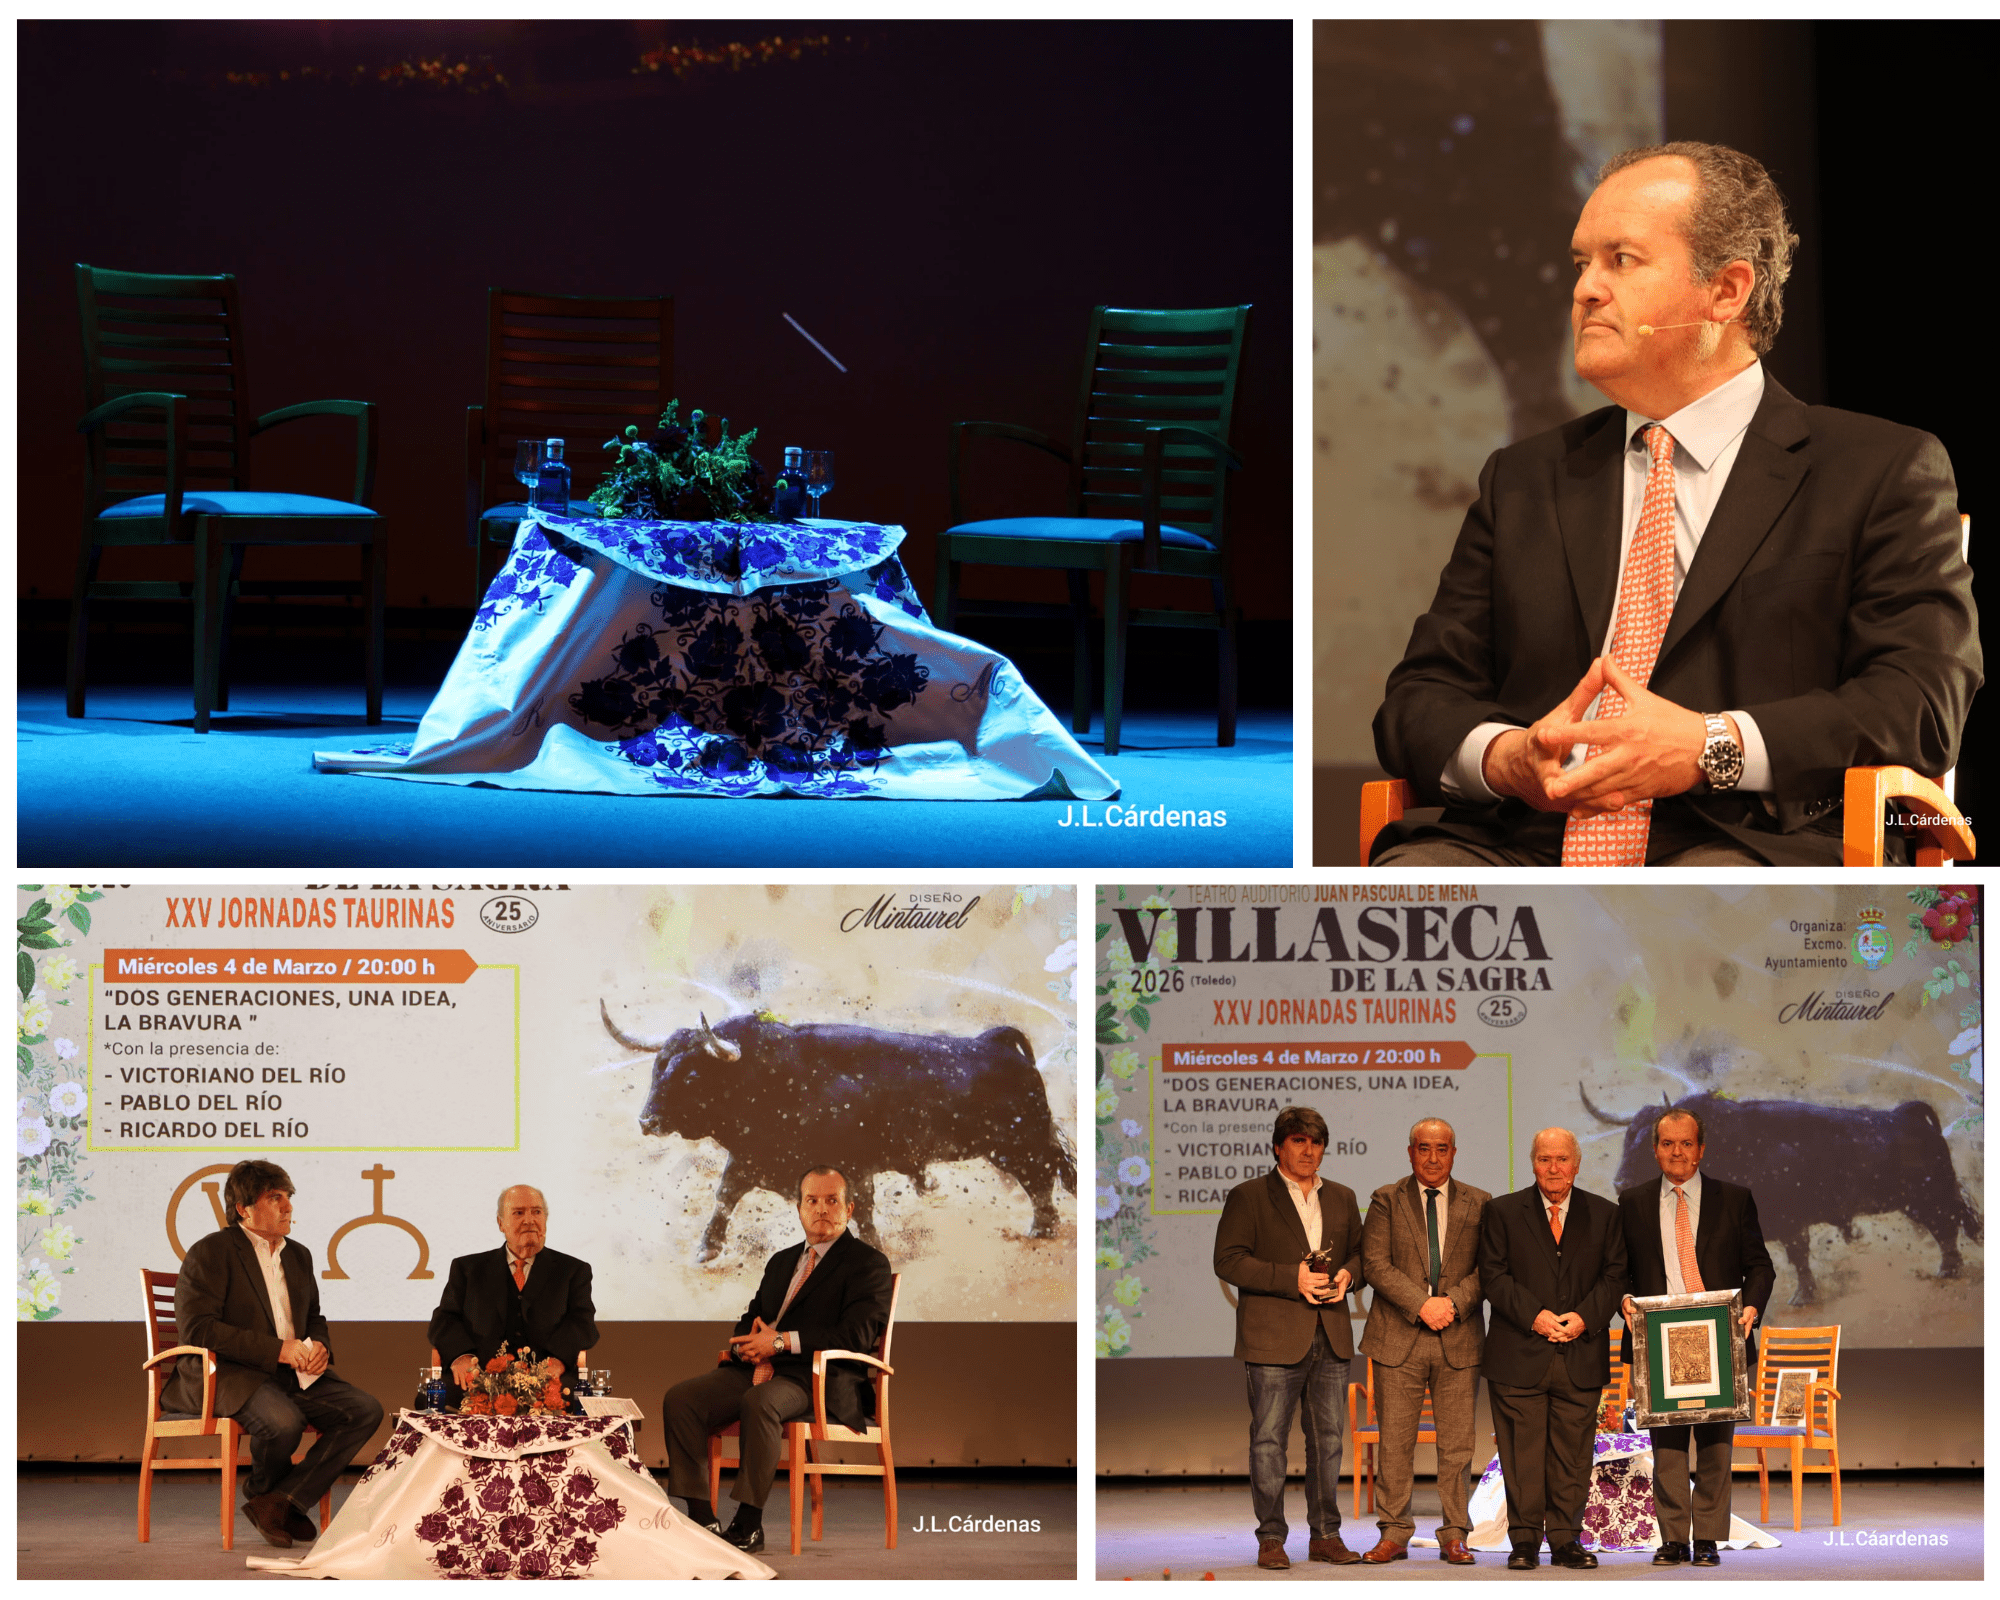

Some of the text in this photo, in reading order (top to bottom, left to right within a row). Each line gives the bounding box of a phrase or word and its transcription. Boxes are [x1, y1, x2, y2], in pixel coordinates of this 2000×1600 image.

[909, 892, 963, 903] DISEÑO
[1187, 884, 1479, 902] TEATRO AUDITORIO JUAN PASCUAL DE MENA
[165, 896, 455, 928] XXV JORNADAS TAURINAS
[495, 901, 521, 921] 25
[840, 893, 981, 933] Mintaurel
[483, 915, 536, 931] ANIVERSARIO
[1790, 919, 1846, 935] Organiza:
[1112, 904, 1554, 963] VILLASECA
[1804, 937, 1847, 950] Excmo.
[118, 957, 218, 975] Miércoles
[223, 959, 236, 975] 4
[242, 957, 267, 975] de
[273, 959, 337, 975] Marzo
[357, 958, 416, 975] 20:00
[422, 957, 435, 975] h
[1765, 955, 1847, 971] Ayuntamiento
[1131, 969, 1236, 993] 2026 (Toledo)
[1330, 966, 1554, 992] DE LA SAGRA
[167, 990, 341, 1009] GENERACIONES,
[349, 990, 395, 1006] UNA
[402, 990, 457, 1009] IDEA,
[1835, 989, 1880, 999] DISEÑO
[1213, 998, 1457, 1025] XXV JORNADAS TAURINAS
[1490, 1000, 1512, 1016] 25
[1778, 990, 1895, 1025] Mintaurel
[105, 1014, 132, 1031] LA
[139, 1014, 242, 1031] BRAVURA
[150, 1042, 163, 1055] la
[170, 1042, 249, 1058] presencia
[255, 1042, 279, 1055] de:
[1173, 1049, 1259, 1066] Miércoles
[1263, 1051, 1274, 1065] 4
[1278, 1050, 1300, 1065] de
[1304, 1050, 1359, 1065] Marzo
[1375, 1049, 1425, 1064] 20:00
[1429, 1048, 1441, 1063] h
[120, 1067, 254, 1083] VICTORIANO
[262, 1067, 302, 1083] DEL
[310, 1063, 346, 1083] RÍO
[1216, 1076, 1362, 1092] GENERACIONES,
[1368, 1075, 1407, 1090] UNA
[1413, 1075, 1460, 1091] IDEA,
[120, 1094, 190, 1111] PABLO
[198, 1094, 238, 1111] DEL
[246, 1090, 282, 1111] RÍO
[1164, 1098, 1186, 1113] LA
[1193, 1097, 1279, 1112] BRAVURA
[120, 1121, 217, 1138] RICARDO
[225, 1121, 265, 1138] DEL
[272, 1117, 309, 1138] RÍO
[1202, 1121, 1214, 1133] la
[1219, 1122, 1274, 1135] presenc
[1178, 1142, 1274, 1157] VICTORIAN
[1337, 1137, 1368, 1156] RÍO
[1178, 1165, 1237, 1180] PABLO
